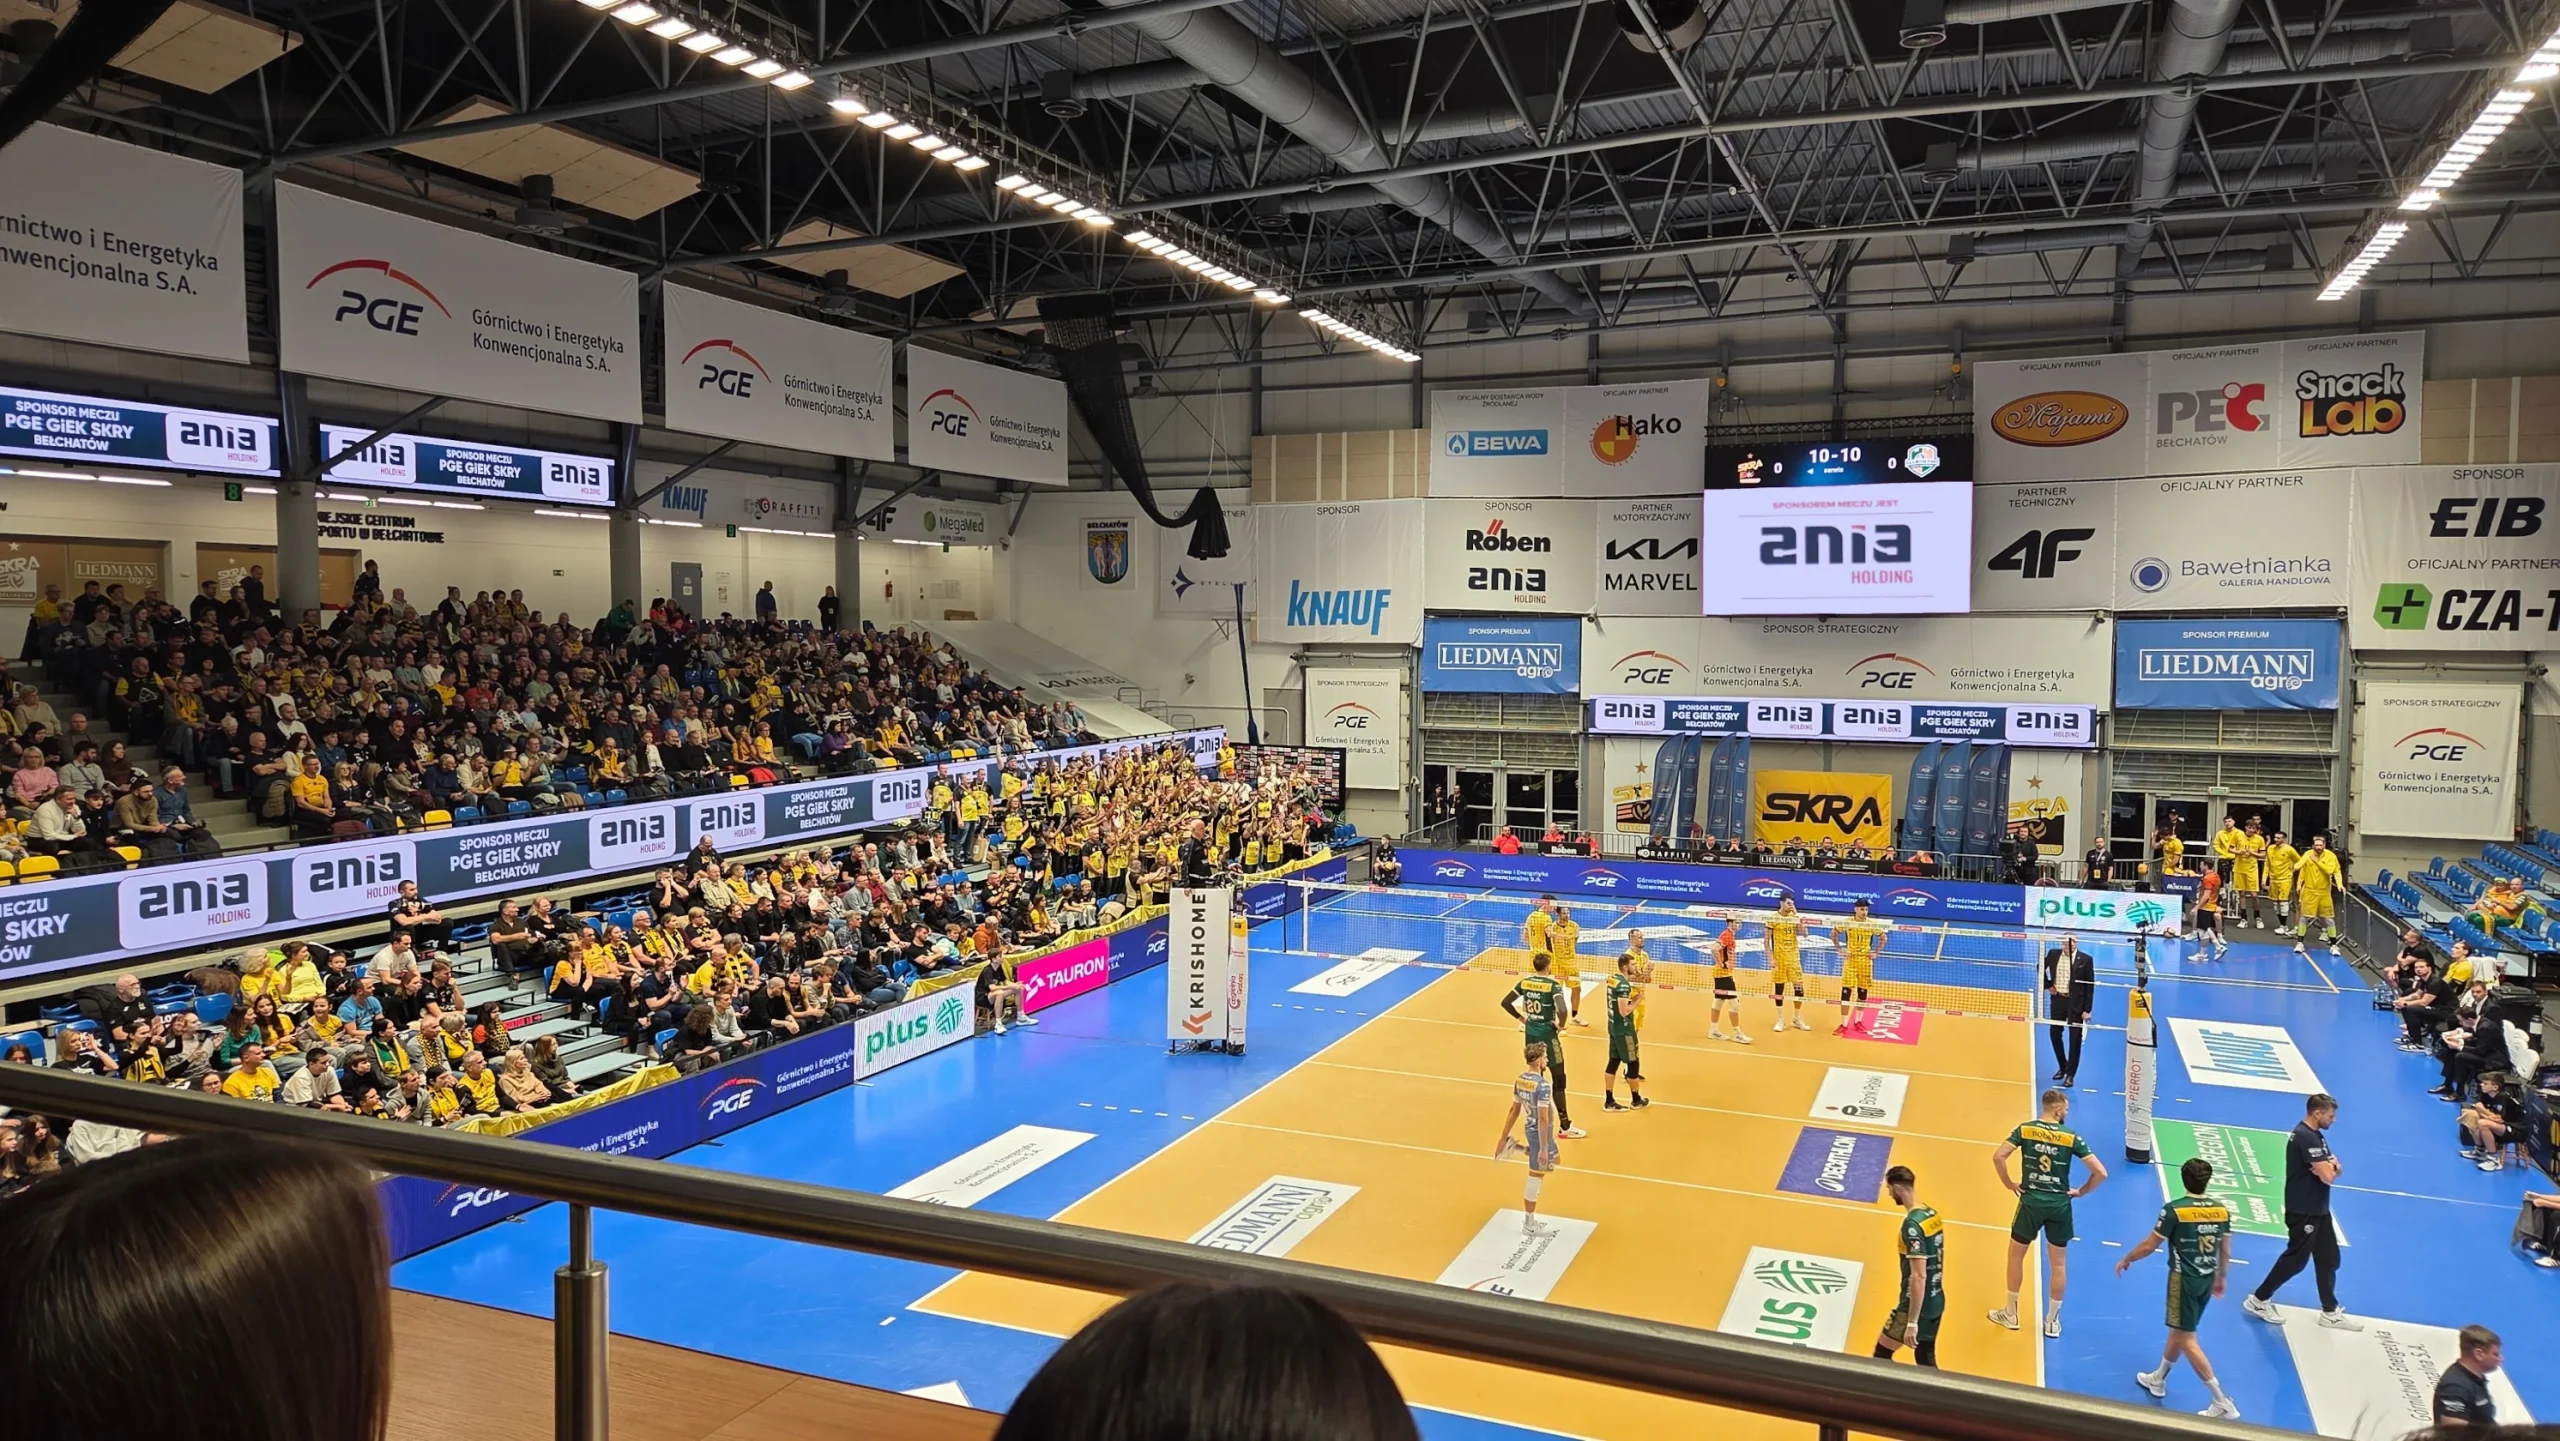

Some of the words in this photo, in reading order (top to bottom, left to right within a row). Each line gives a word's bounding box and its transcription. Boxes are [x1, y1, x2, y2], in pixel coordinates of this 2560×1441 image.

[90, 229, 96, 248] i
[104, 232, 218, 271] Energetyka
[156, 271, 198, 295] S.A.
[472, 308, 543, 339] Górnictwo
[546, 324, 551, 340] i
[554, 331, 624, 357] Energetyka
[473, 333, 582, 369] Konwencjonalna
[586, 353, 611, 373] S.A.
[2307, 341, 2355, 353] OFICJALNY
[2356, 338, 2399, 350] PARTNER
[2172, 350, 2218, 362] OFICJALNY
[2219, 347, 2260, 359] PARTNER
[2019, 362, 2063, 373] OFICJALNY
[2064, 360, 2102, 371] PARTNER
[698, 364, 754, 399] PGE
[784, 373, 829, 396] Górnictwo
[831, 384, 835, 397] i
[837, 387, 883, 406] Energetyka
[2297, 363, 2404, 401] Snack
[1456, 394, 1489, 402] OFICJALNY
[1527, 392, 1545, 400] WODY
[15, 400, 77, 418] SPONSOR
[79, 408, 120, 422] MECZU
[784, 393, 854, 418] Konwencjonalna
[857, 406, 875, 422] S.A.
[2157, 381, 2270, 436] PEC
[931, 410, 970, 438] PGE
[1616, 414, 1682, 436] Hako
[2006, 402, 2118, 437] Majami
[2299, 396, 2407, 439] Lab
[5, 413, 43, 431] PGE
[46, 418, 88, 436] GiEK
[90, 422, 134, 440] SKRY
[989, 415, 1022, 432] Górnictwo
[1027, 423, 1061, 440] Energetyka
[34, 434, 109, 452] BEŁCHATÓW
[1473, 436, 1542, 451] BEWA
[2156, 435, 2229, 449] BEŁCHATÓW
[446, 449, 484, 463] SPONSOR
[486, 454, 513, 465] MECZU
[1808, 446, 1862, 464] 10-10
[1887, 457, 1898, 470] 0
[439, 459, 463, 472] PGE
[493, 466, 522, 479] SKRY
[2452, 468, 2525, 480] SPONSOR
[457, 476, 506, 489] BEŁCHATÓW
[2160, 479, 2235, 493] OFICJALNY
[2238, 475, 2304, 490] PARTNER
[662, 477, 709, 520] KNAUF
[2017, 486, 2068, 497] PARTNER
[1317, 504, 1361, 516] SPONSOR
[1484, 502, 1533, 512] SPONSOR
[1632, 503, 1673, 513] PARTNER
[1772, 501, 1836, 510] SPONSOREM
[1837, 500, 1873, 509] MECZU
[1874, 499, 1899, 508] JEST
[2008, 497, 2077, 509] TECHNICZNY
[365, 514, 416, 529] CENTRUM
[938, 516, 985, 534] MegaMed
[1613, 512, 1692, 523] MOTORYZACYJNY
[2429, 496, 2546, 538] EIB
[359, 529, 369, 541] W
[1465, 518, 1551, 554] Röben
[1987, 528, 2096, 579] 4F
[77, 563, 156, 578] LIEDMANN
[2181, 556, 2332, 578] Bawełnianka
[2407, 558, 2488, 570] OFICJALNY
[2491, 558, 2560, 570] PARTNER
[1604, 573, 1699, 591] MARVEL
[1851, 569, 1914, 585] HOLDING
[2219, 578, 2265, 588] GALERIA
[2266, 576, 2332, 588] HANDLOWA
[1287, 579, 1392, 636] KNAUF
[1514, 594, 1547, 604] HOLDING
[1468, 628, 1500, 636] SPONSOR
[1500, 628, 1532, 636] PREMIUM
[1762, 624, 1815, 635] SPONSOR
[1817, 624, 1899, 634] STRATEGICZNY
[2182, 630, 2226, 640] SPONSOR
[2227, 630, 2270, 639] PREMIUM
[1441, 647, 1559, 667] LIEDMANN
[2143, 653, 2310, 677] LIEDMANN
[1624, 668, 1674, 685] PGE
[1703, 664, 1752, 676] Górnictwo
[1753, 665, 1758, 675] i
[1759, 665, 1813, 678] Energetyka
[1950, 667, 2004, 679] Górnictwo
[2006, 668, 2011, 679] i
[2013, 668, 2075, 682] Energetyka
[1703, 676, 1780, 689] Konwencjonalna
[1782, 677, 1802, 688] S.A.
[1860, 671, 1917, 689] PGE
[1949, 680, 2036, 694] Konwencjonalna
[2039, 681, 2063, 693] S.A.
[1677, 704, 1709, 712] SPONSOR
[1709, 704, 1733, 712] MECZU
[2383, 698, 2429, 707] SPONSOR
[2431, 699, 2501, 708] STRATEGICZNY
[1672, 711, 1692, 720] PGE
[1715, 711, 1740, 722] SKRY
[1919, 716, 1942, 727] PGE
[1968, 718, 1997, 728] SKRY
[1926, 709, 1962, 718] SPONSOR
[1962, 710, 1988, 718] MECZU
[2409, 744, 2468, 761] PGE
[2378, 770, 2432, 781] Górnictwo
[2440, 772, 2500, 785] Energetyka
[790, 790, 825, 803] SPONSOR
[825, 786, 849, 798] MECZU
[2384, 783, 2469, 795] Konwencjonalna
[2471, 786, 2494, 795] S.A.
[784, 805, 806, 819] PGE
[831, 797, 856, 812] SKRY
[1762, 792, 1883, 835] SKRA
[799, 814, 843, 830] BEŁCHATÓW
[459, 833, 512, 851] SPONSOR
[514, 828, 549, 844] MECZU
[640, 841, 666, 855] HOLDING
[450, 853, 483, 872] PGE
[485, 848, 521, 867] GiEK
[524, 841, 562, 860] SKRY
[474, 862, 540, 884] BEŁCHATÓW
[1583, 875, 1619, 888] PGE
[1892, 895, 1928, 907] PGE
[2039, 895, 2116, 919] plus
[207, 909, 251, 926] HOLDING
[5, 913, 71, 942] SKRY
[1189, 893, 1206, 1009] KRISHOME
[1046, 954, 1105, 990] TAURON
[1526, 1000, 1542, 1014] 20
[864, 1014, 929, 1063] plus
[2190, 1028, 2292, 1082] KNAUF
[2129, 1058, 2143, 1102] PIERROT
[605, 1120, 660, 1147] Energetyka
[628, 1138, 650, 1152] S.A.
[1820, 1135, 1858, 1181] DECATHLON
[2246, 1196, 2273, 1224] REGION
[1755, 1298, 1818, 1347] us
